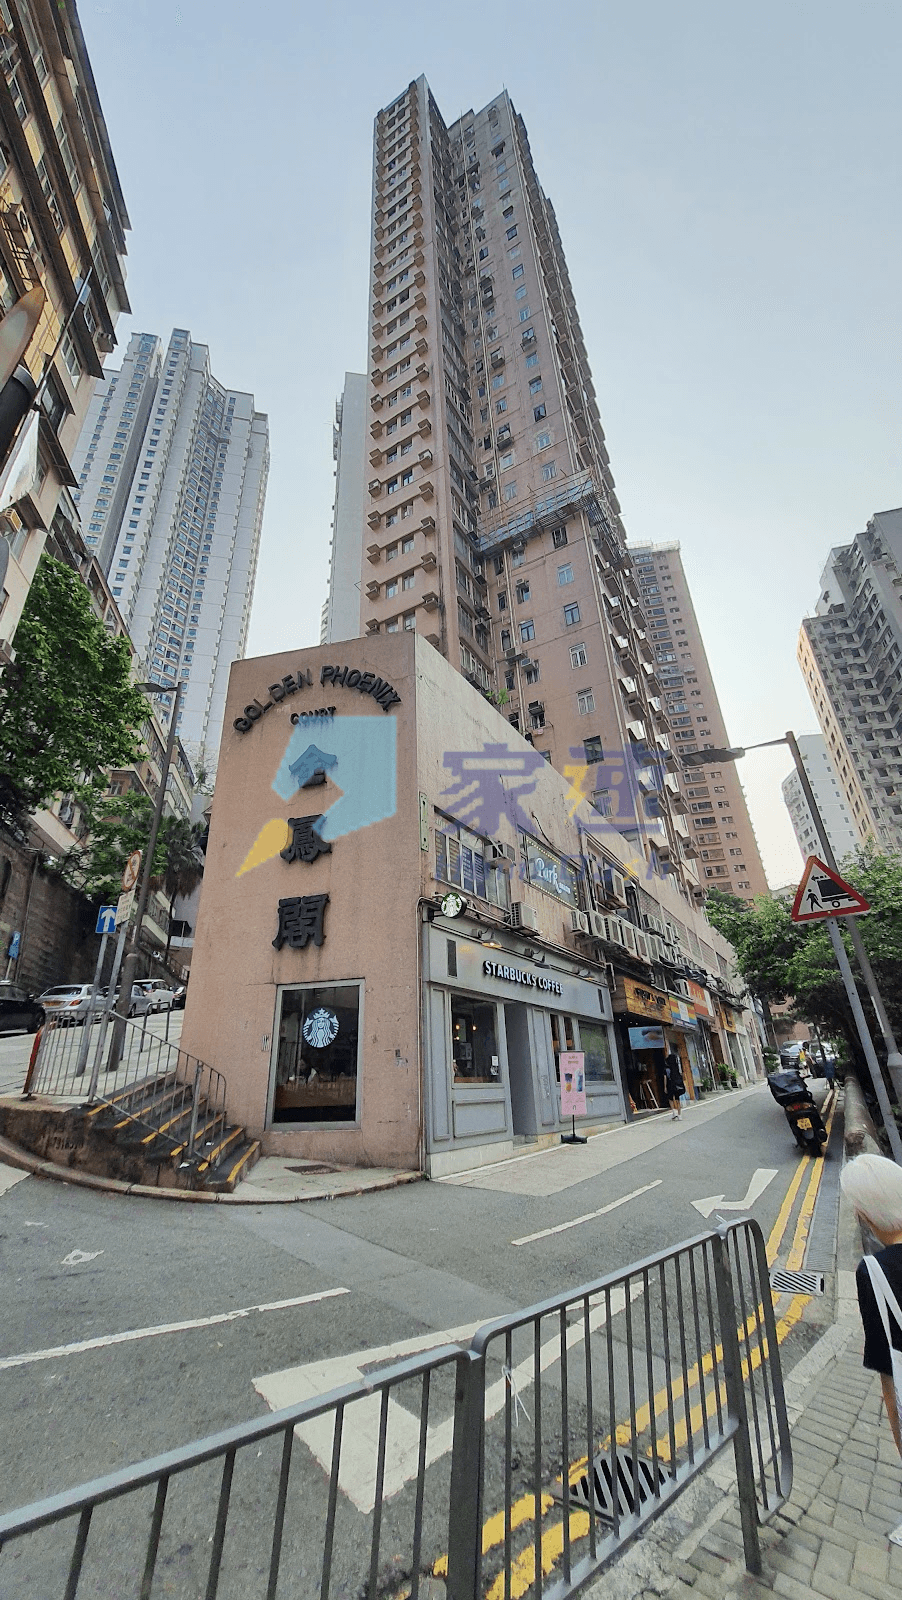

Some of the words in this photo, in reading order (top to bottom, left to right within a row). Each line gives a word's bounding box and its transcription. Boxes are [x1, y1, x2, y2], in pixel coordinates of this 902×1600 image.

[233, 668, 313, 733] GOLDEN
[320, 665, 401, 712] PHOENIX
[290, 706, 337, 726] COURT
[484, 960, 537, 986] STARBUCKS
[538, 976, 564, 994] COFFEE
